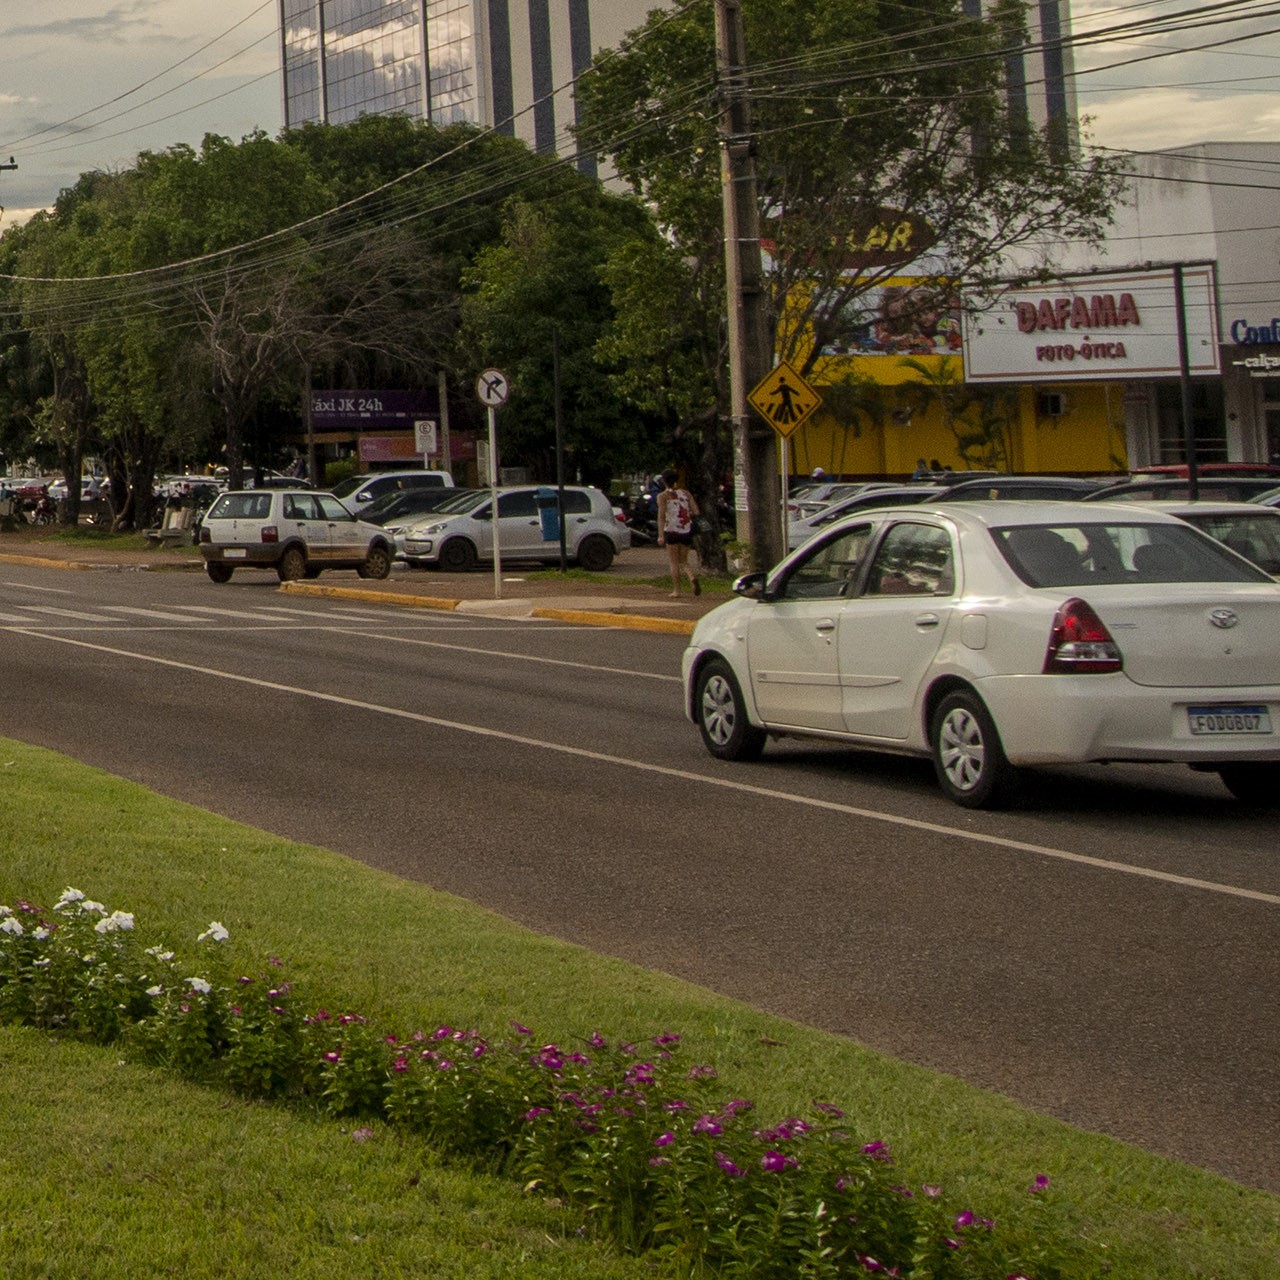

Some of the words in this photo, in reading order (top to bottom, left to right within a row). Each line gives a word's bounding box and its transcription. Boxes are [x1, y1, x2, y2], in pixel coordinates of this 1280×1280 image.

[1016, 293, 1140, 334] DAFAMA
[1230, 317, 1280, 345] Conf
[338, 399, 355, 412] JK
[358, 398, 383, 412] 24h
